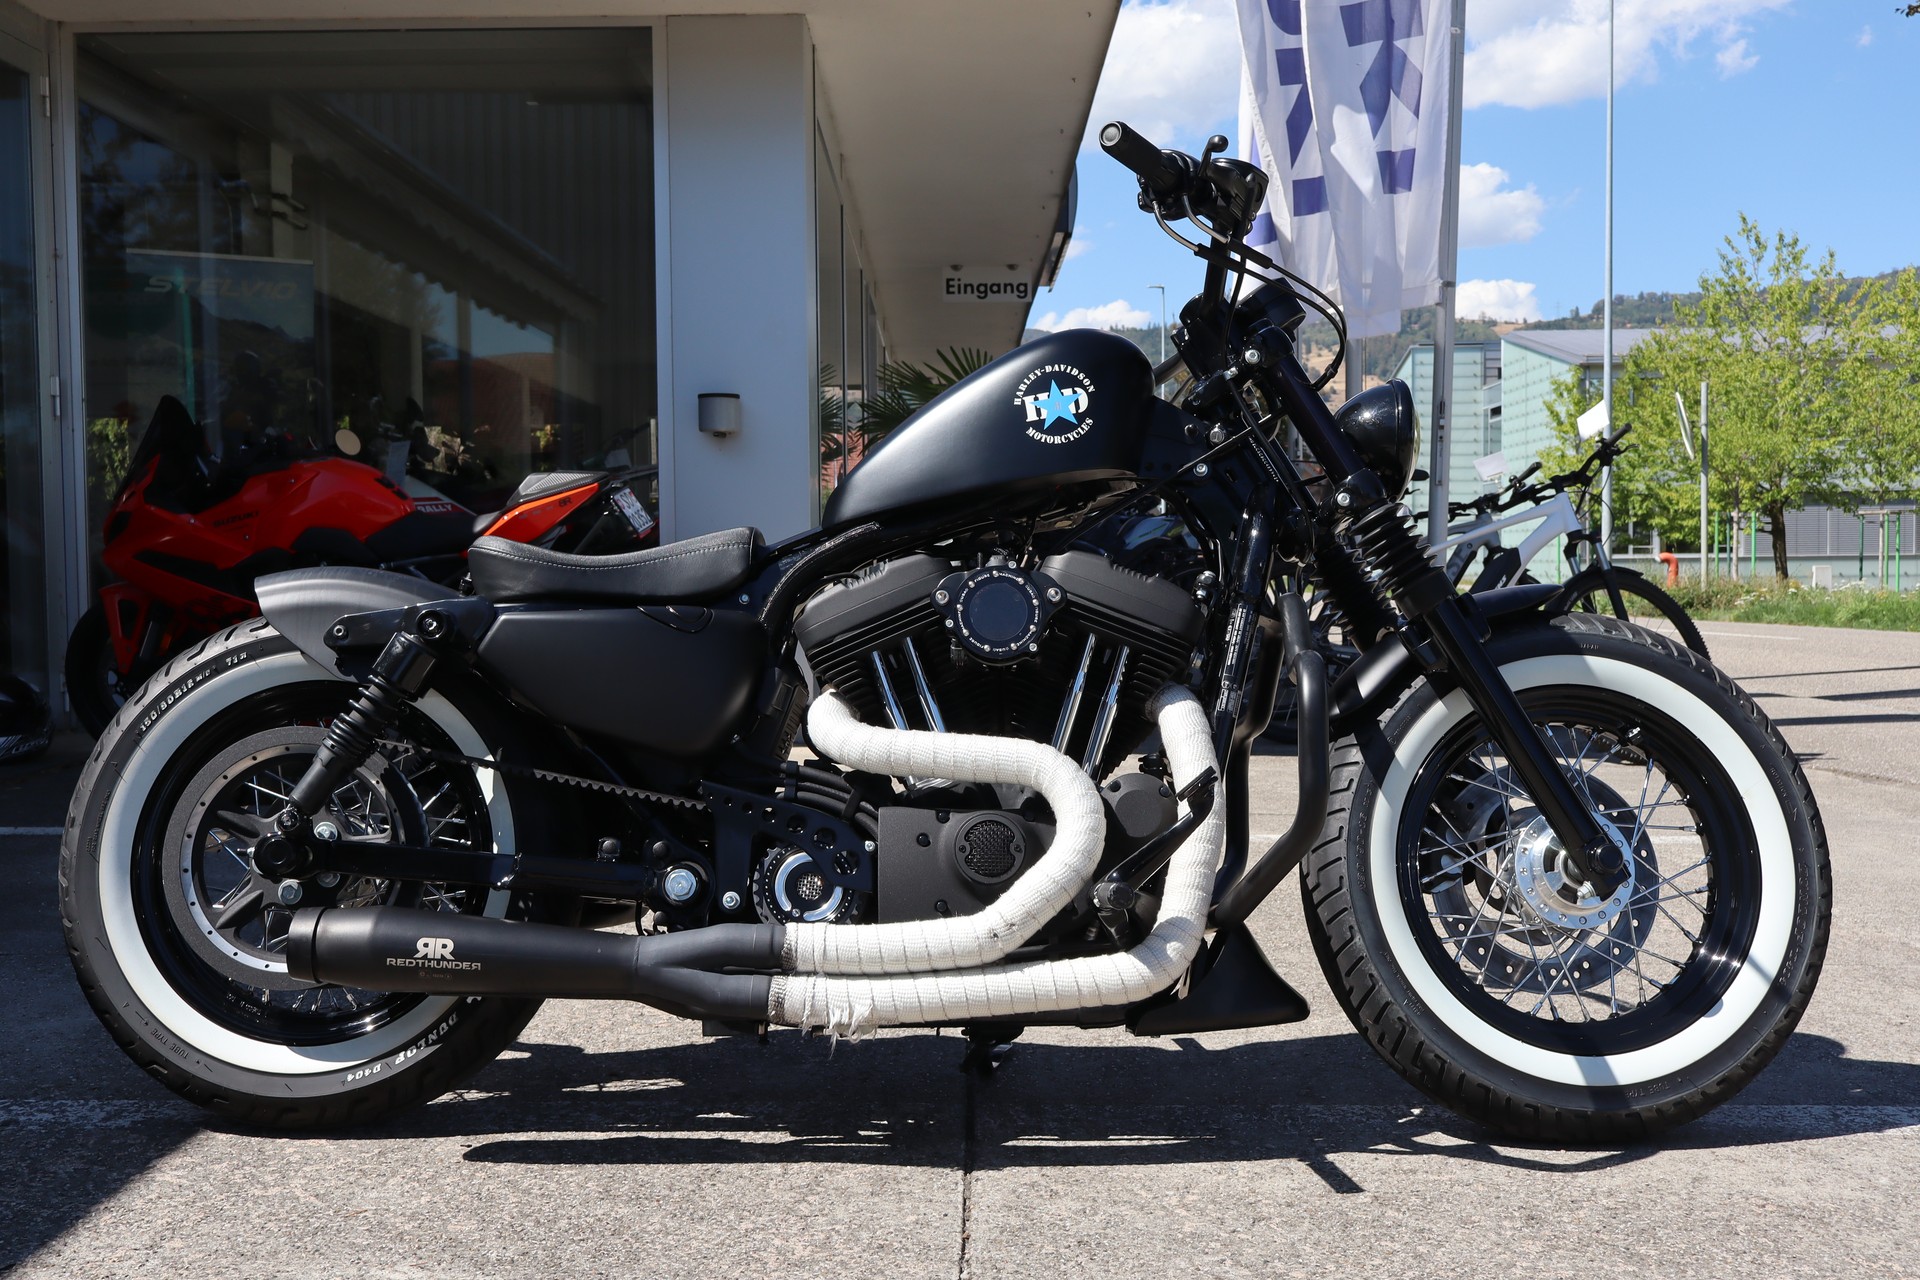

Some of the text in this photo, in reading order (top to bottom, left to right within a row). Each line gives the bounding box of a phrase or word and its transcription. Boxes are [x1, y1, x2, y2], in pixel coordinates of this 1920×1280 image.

[143, 275, 299, 299] STELVIO
[945, 277, 1029, 300] Eingang
[1013, 363, 1096, 406] HARLEY-DAVIDSON
[1025, 417, 1094, 445] MOTORCYCLES
[386, 957, 481, 971] REDTHUNDER
[151, 1027, 190, 1060] TUBE TYPE
[346, 1011, 458, 1082] DUNLOP D404
